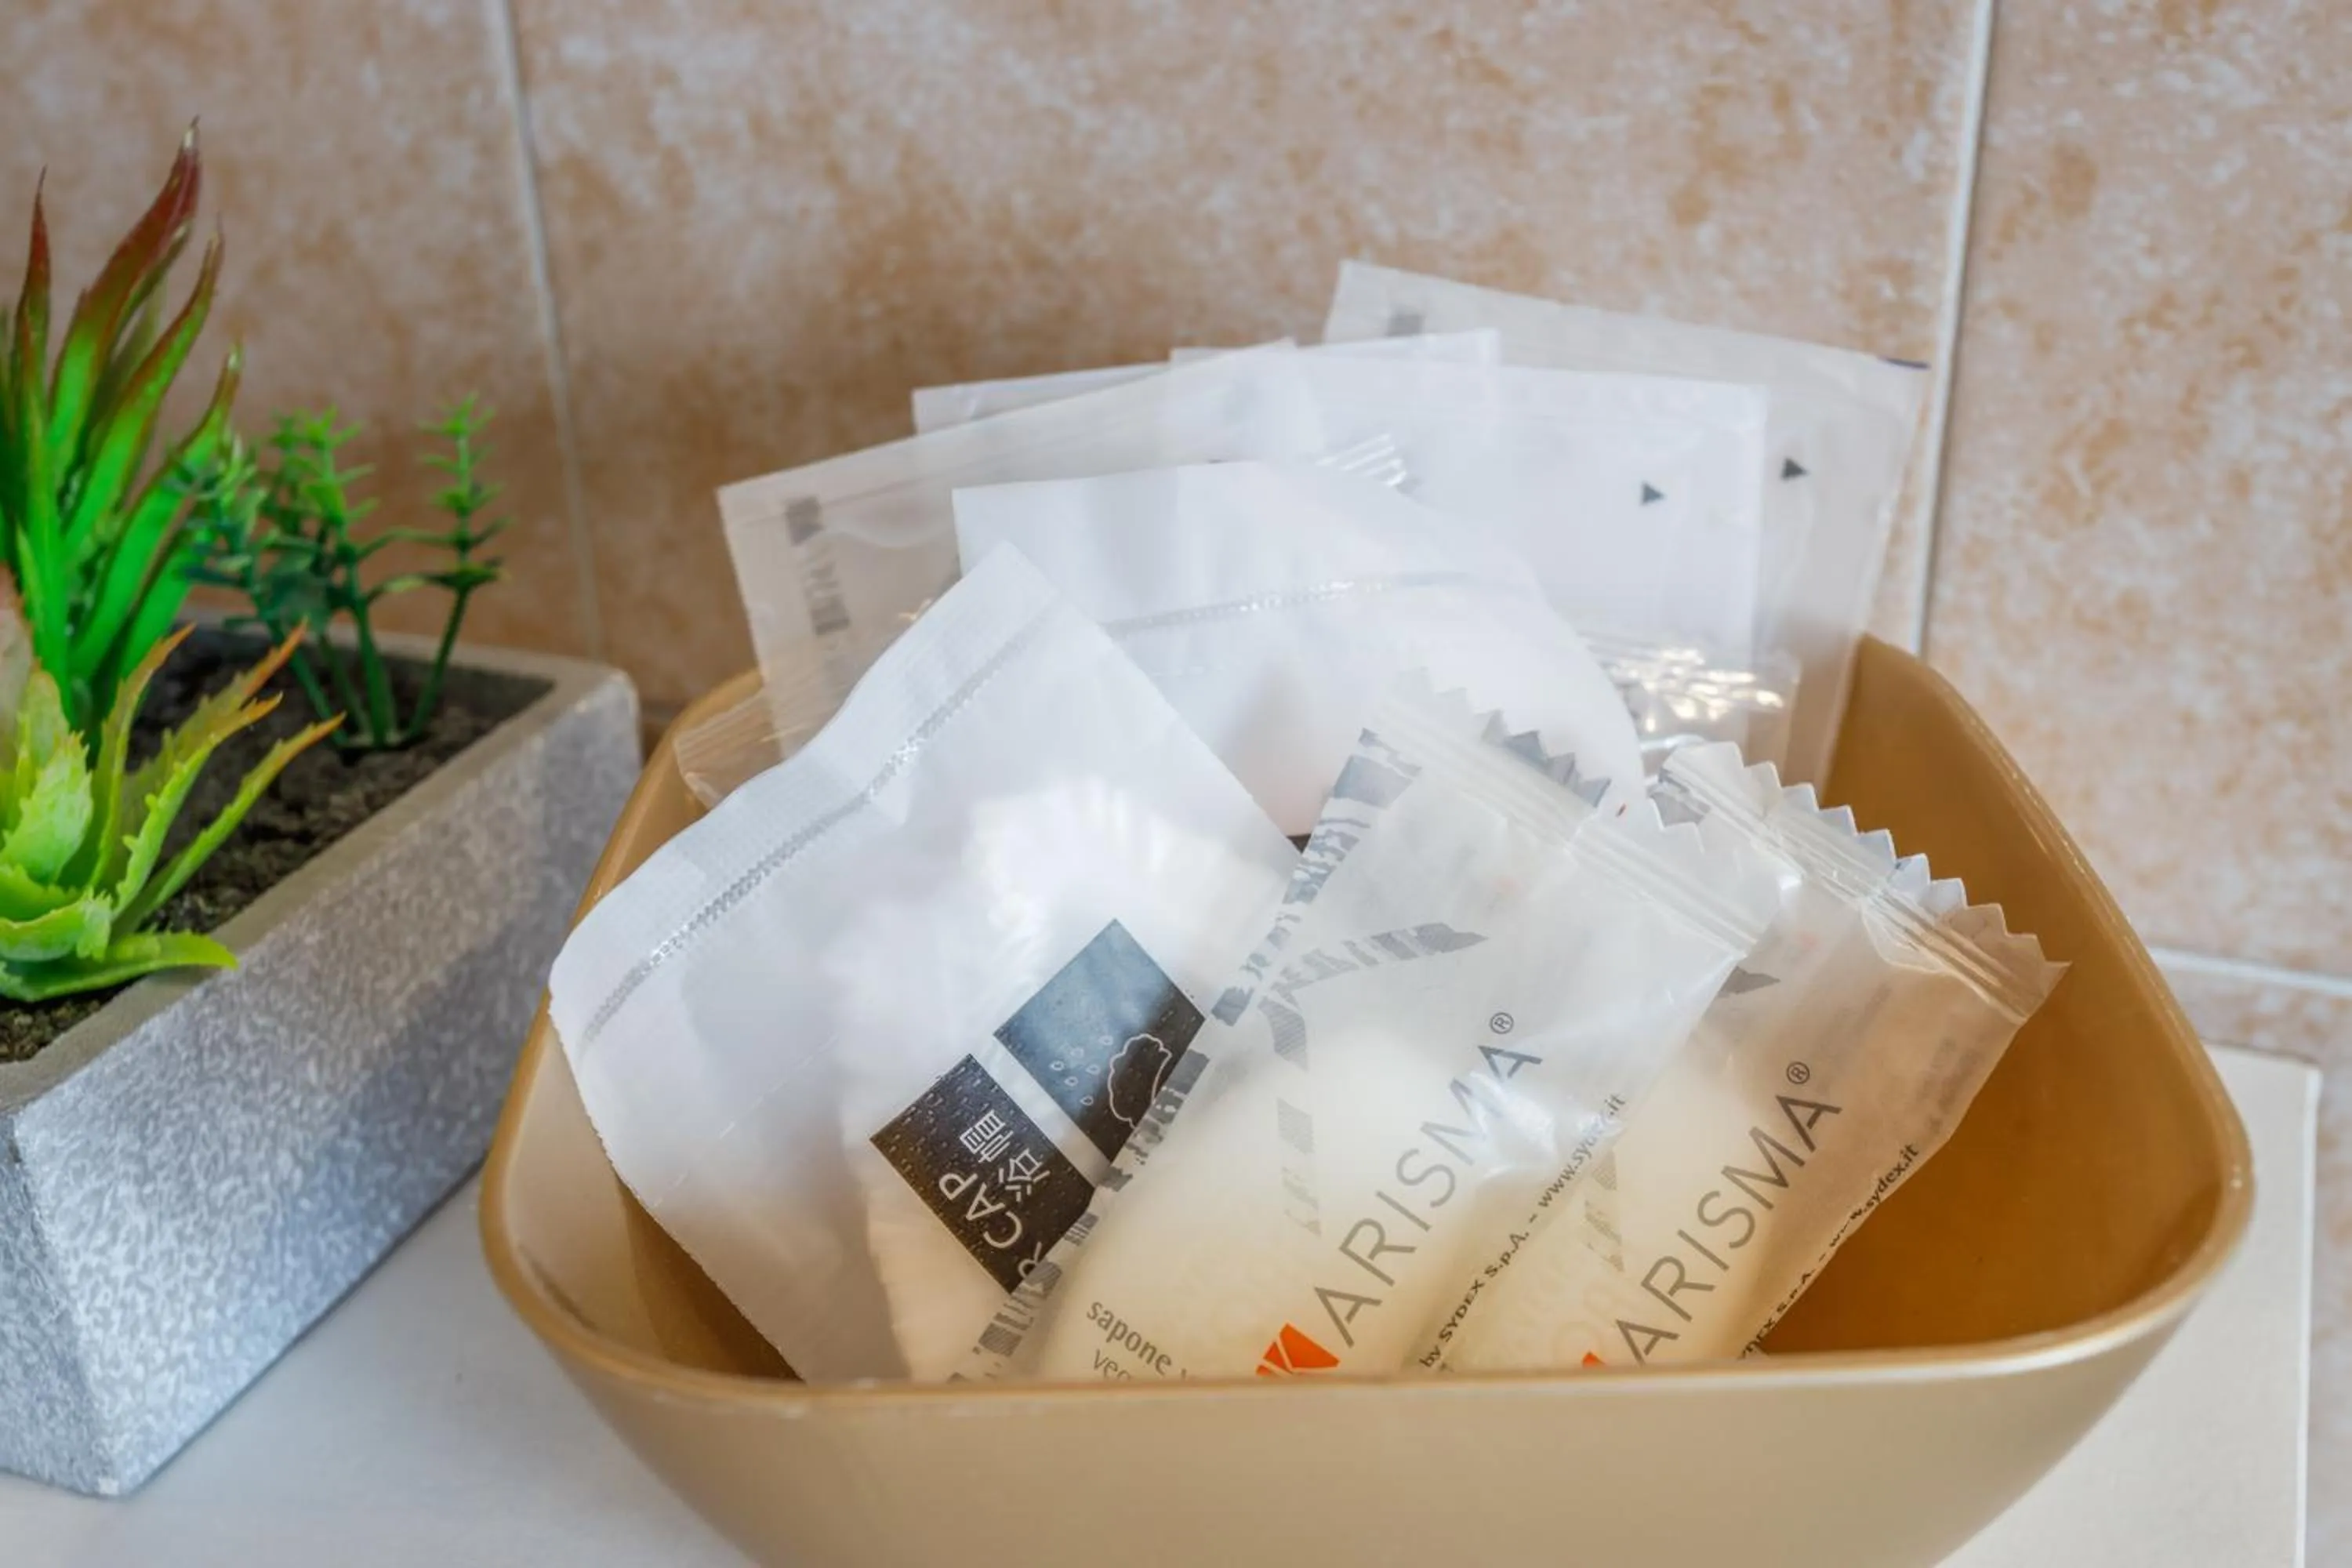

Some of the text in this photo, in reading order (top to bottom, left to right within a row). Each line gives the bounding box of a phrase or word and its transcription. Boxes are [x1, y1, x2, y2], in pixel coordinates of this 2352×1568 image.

[960, 1110, 1051, 1202] 浴帽
[938, 1172, 1022, 1250] CAP
[1419, 1345, 1441, 1367] by
[1438, 1279, 1485, 1343] SYDEX
[1484, 1232, 1530, 1278] S.p.A.
[1537, 1093, 1626, 1207] www.sy.it
[1086, 1301, 1173, 1377] sapone
